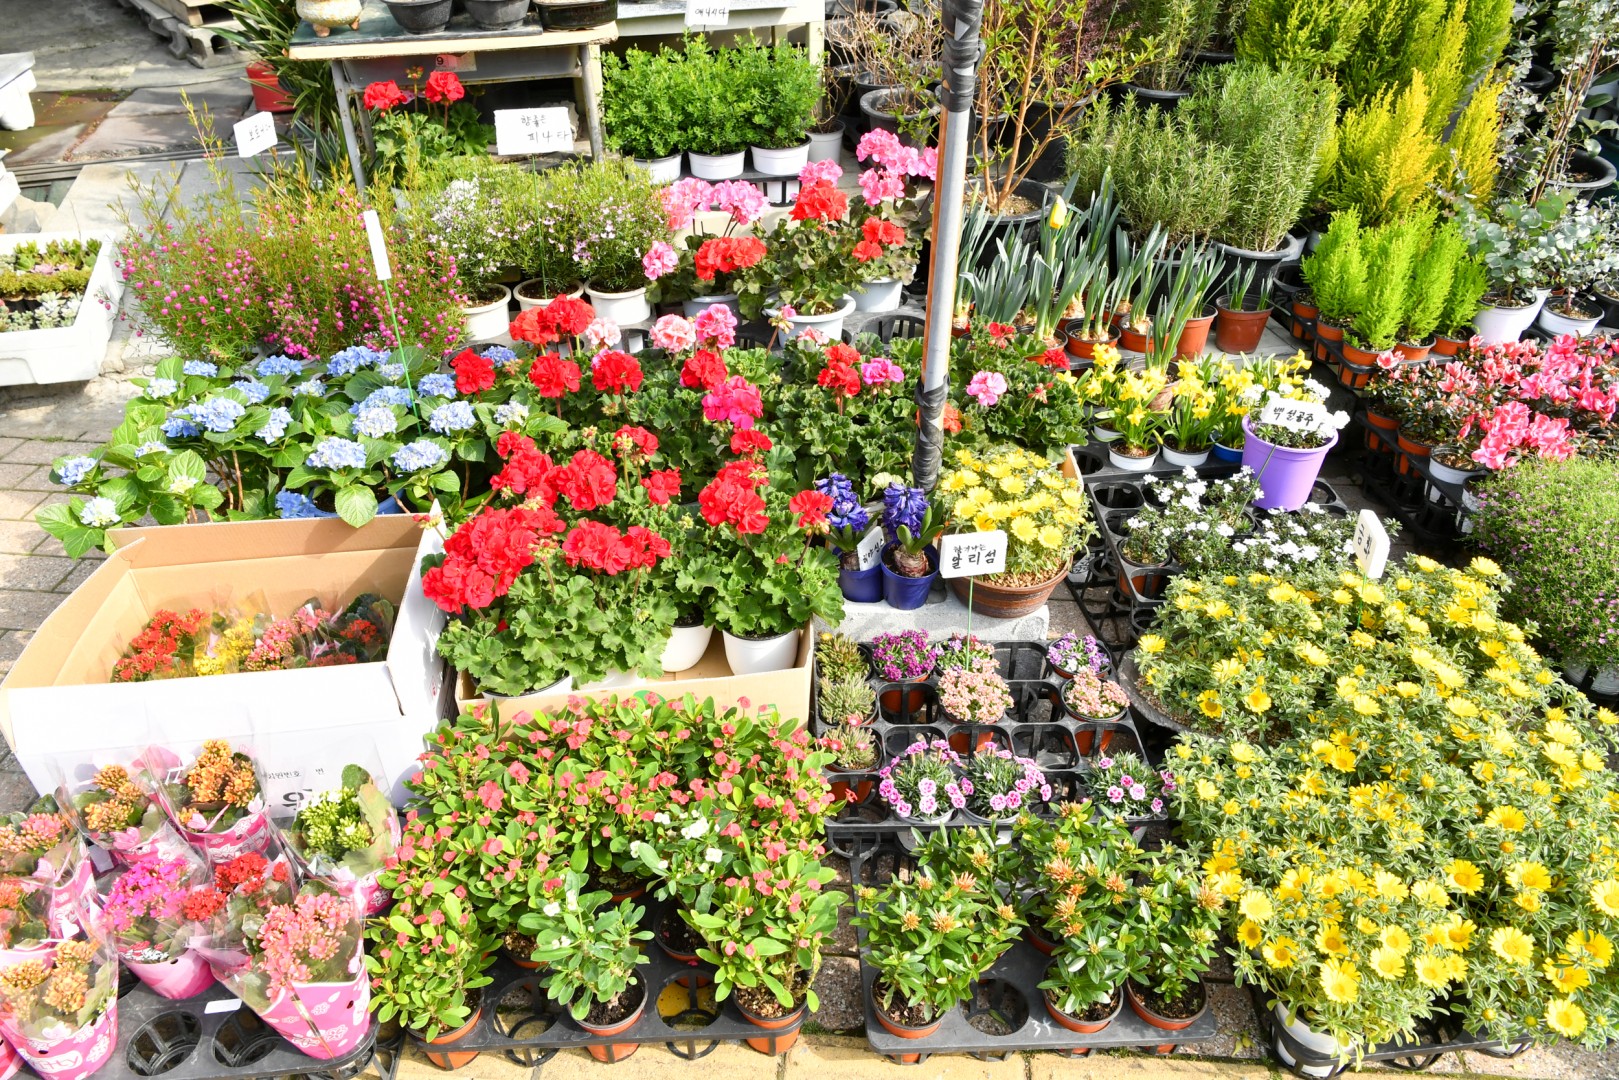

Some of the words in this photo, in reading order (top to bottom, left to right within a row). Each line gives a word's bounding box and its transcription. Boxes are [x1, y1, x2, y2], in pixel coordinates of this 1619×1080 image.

[527, 130, 570, 143] 피나타
[1273, 407, 1314, 426] 백설공주
[951, 549, 997, 570] 알리섬
